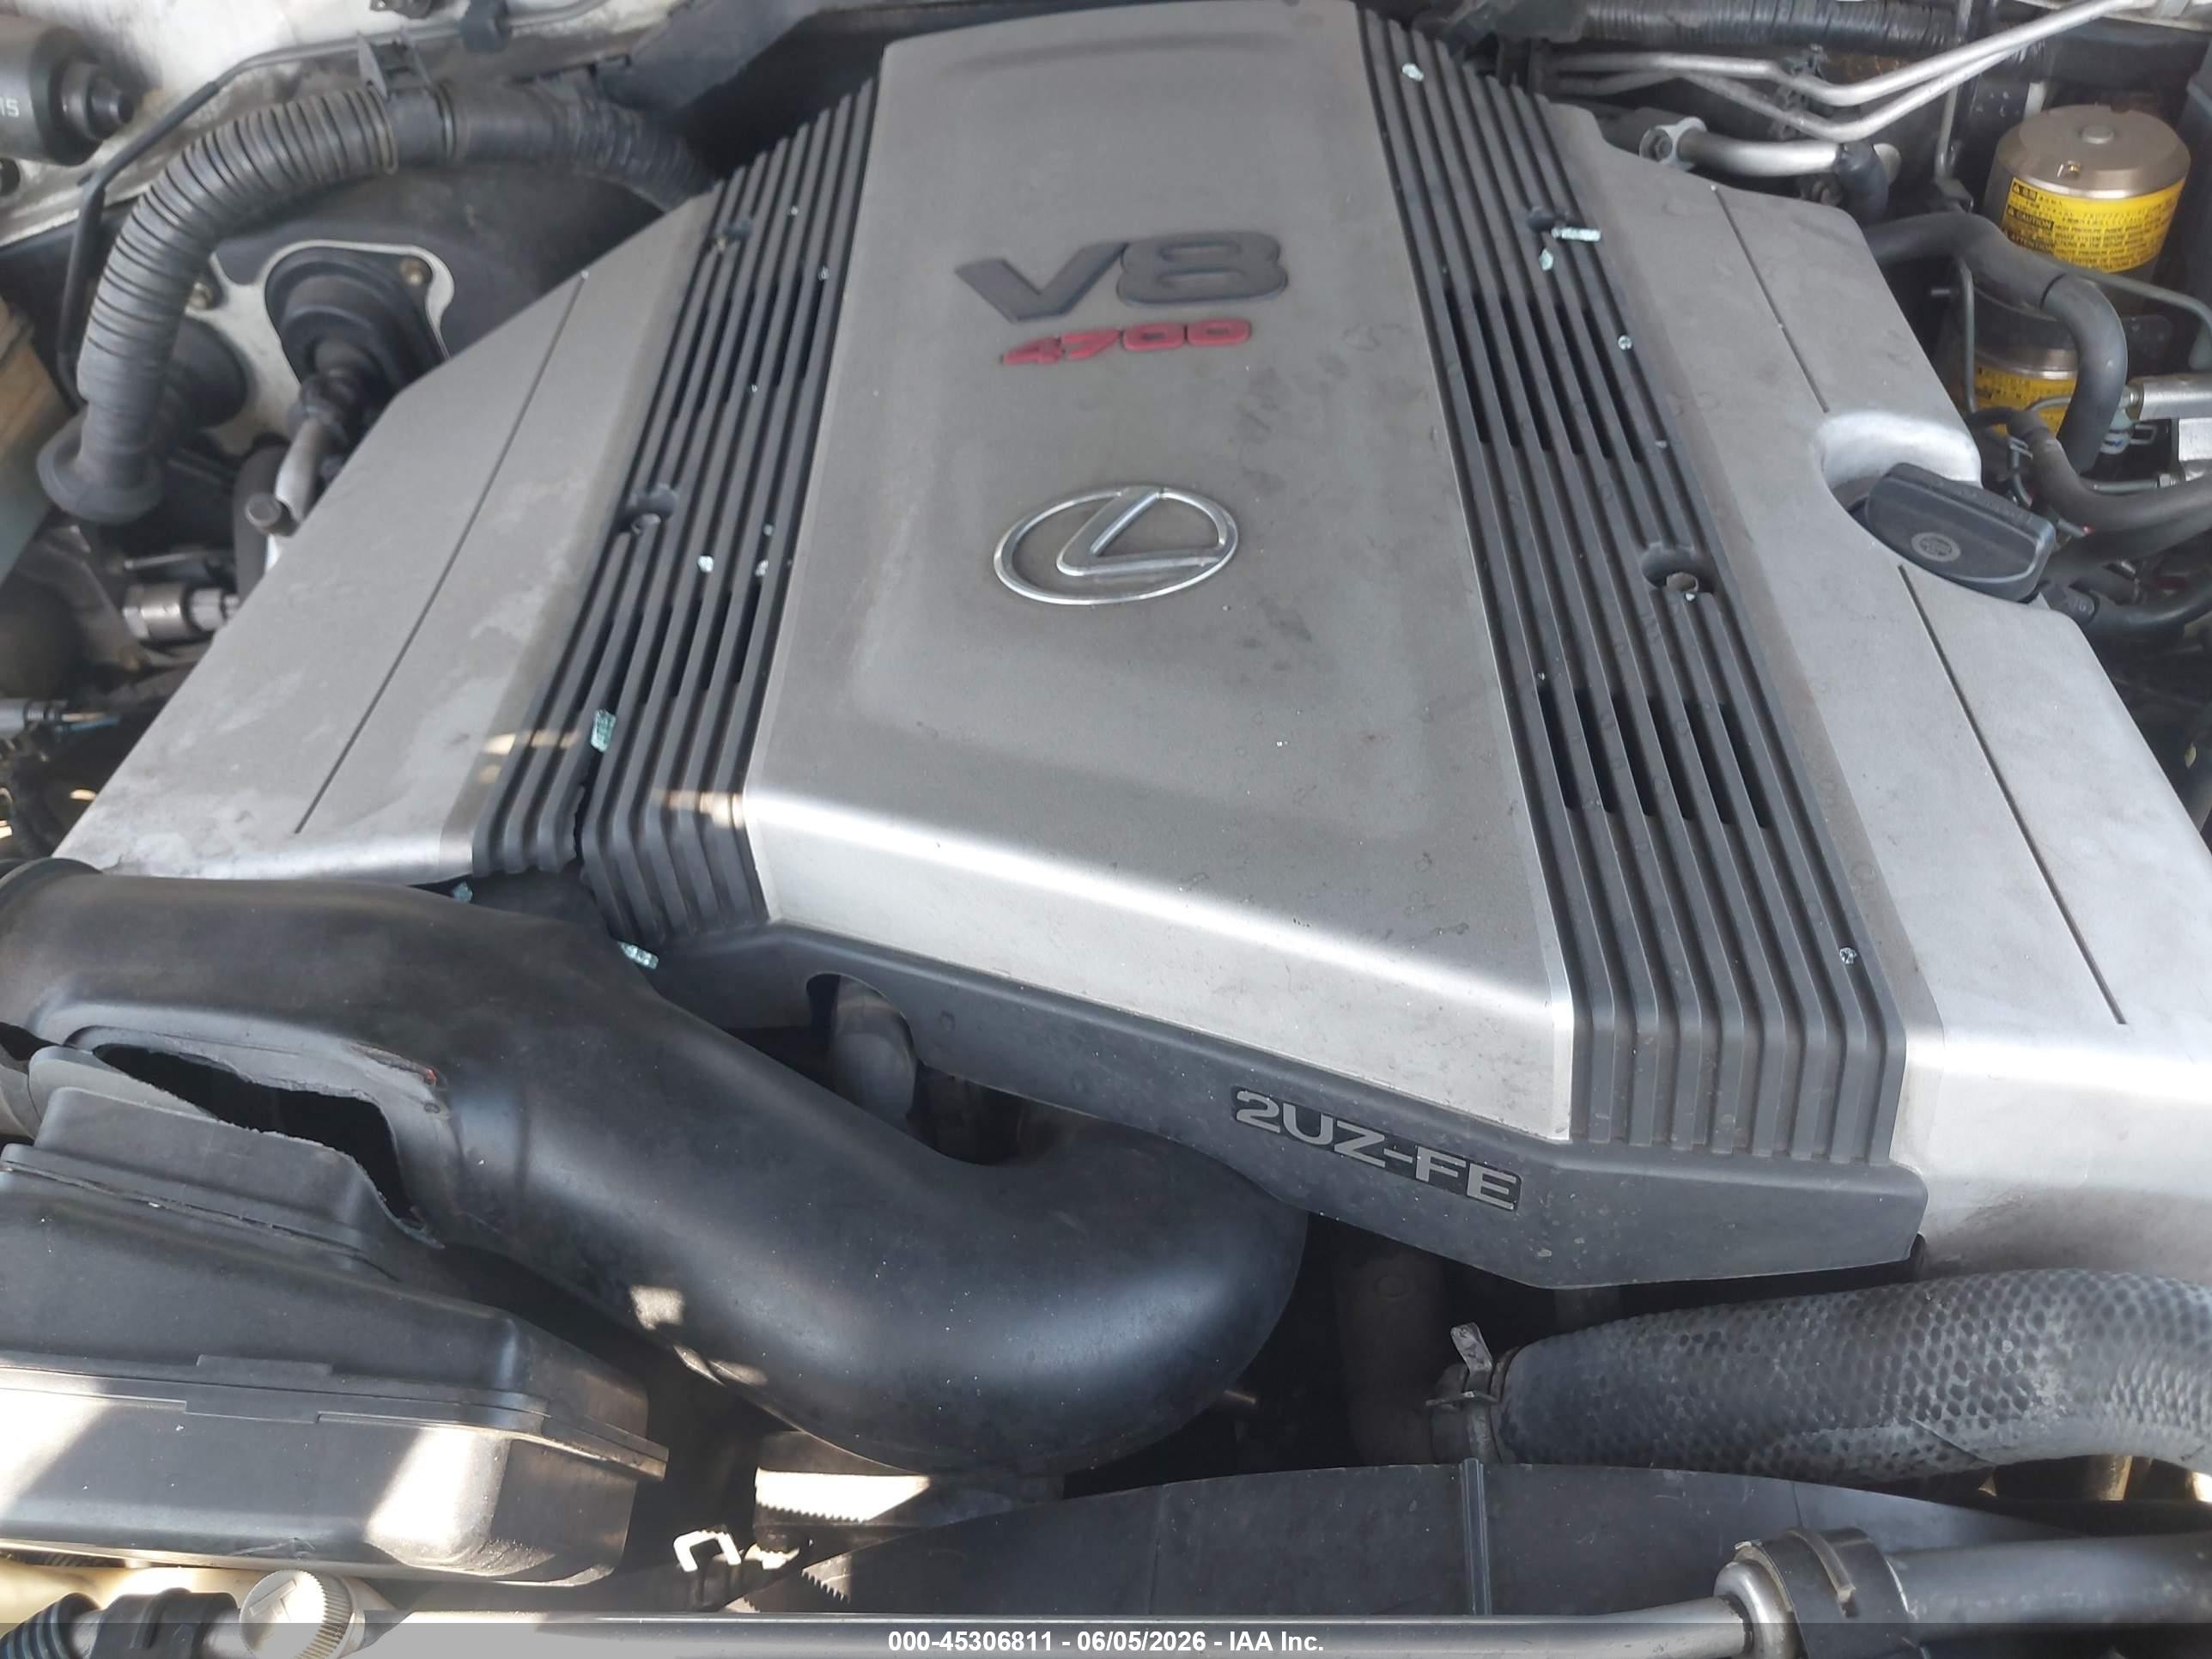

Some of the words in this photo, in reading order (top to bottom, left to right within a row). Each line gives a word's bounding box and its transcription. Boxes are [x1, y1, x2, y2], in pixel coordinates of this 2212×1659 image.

[954, 231, 1289, 324] V8
[1000, 318, 1251, 365] 4700
[1236, 1090, 1517, 1211] 2UZ-FE
